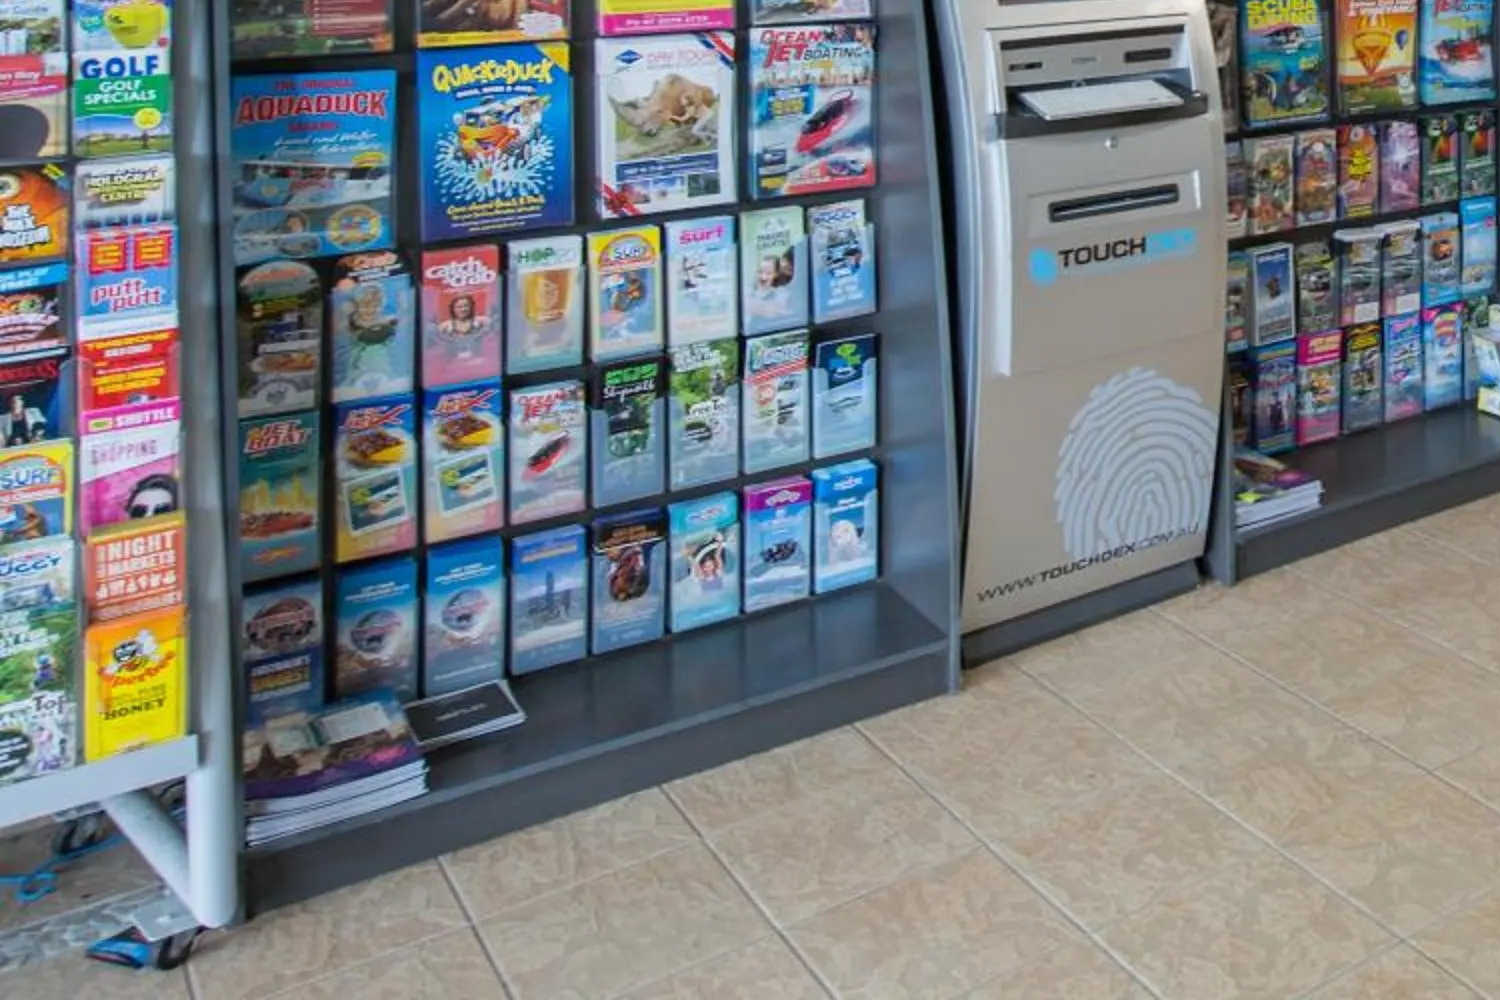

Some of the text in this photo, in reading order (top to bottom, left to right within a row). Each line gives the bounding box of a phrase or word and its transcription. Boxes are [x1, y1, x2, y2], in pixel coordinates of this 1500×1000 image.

[760, 30, 823, 44] OCEAN
[764, 40, 862, 69] JET BOATING
[81, 55, 159, 80] GOLF
[84, 90, 156, 105] SPECIALS
[99, 79, 142, 92] GOLF
[234, 89, 389, 127] AQUADUCK
[93, 279, 144, 302] putt
[113, 290, 162, 312] putt
[91, 439, 157, 466] SHOPPING
[108, 531, 175, 558] NIGHT
[103, 697, 166, 721] HONEY
